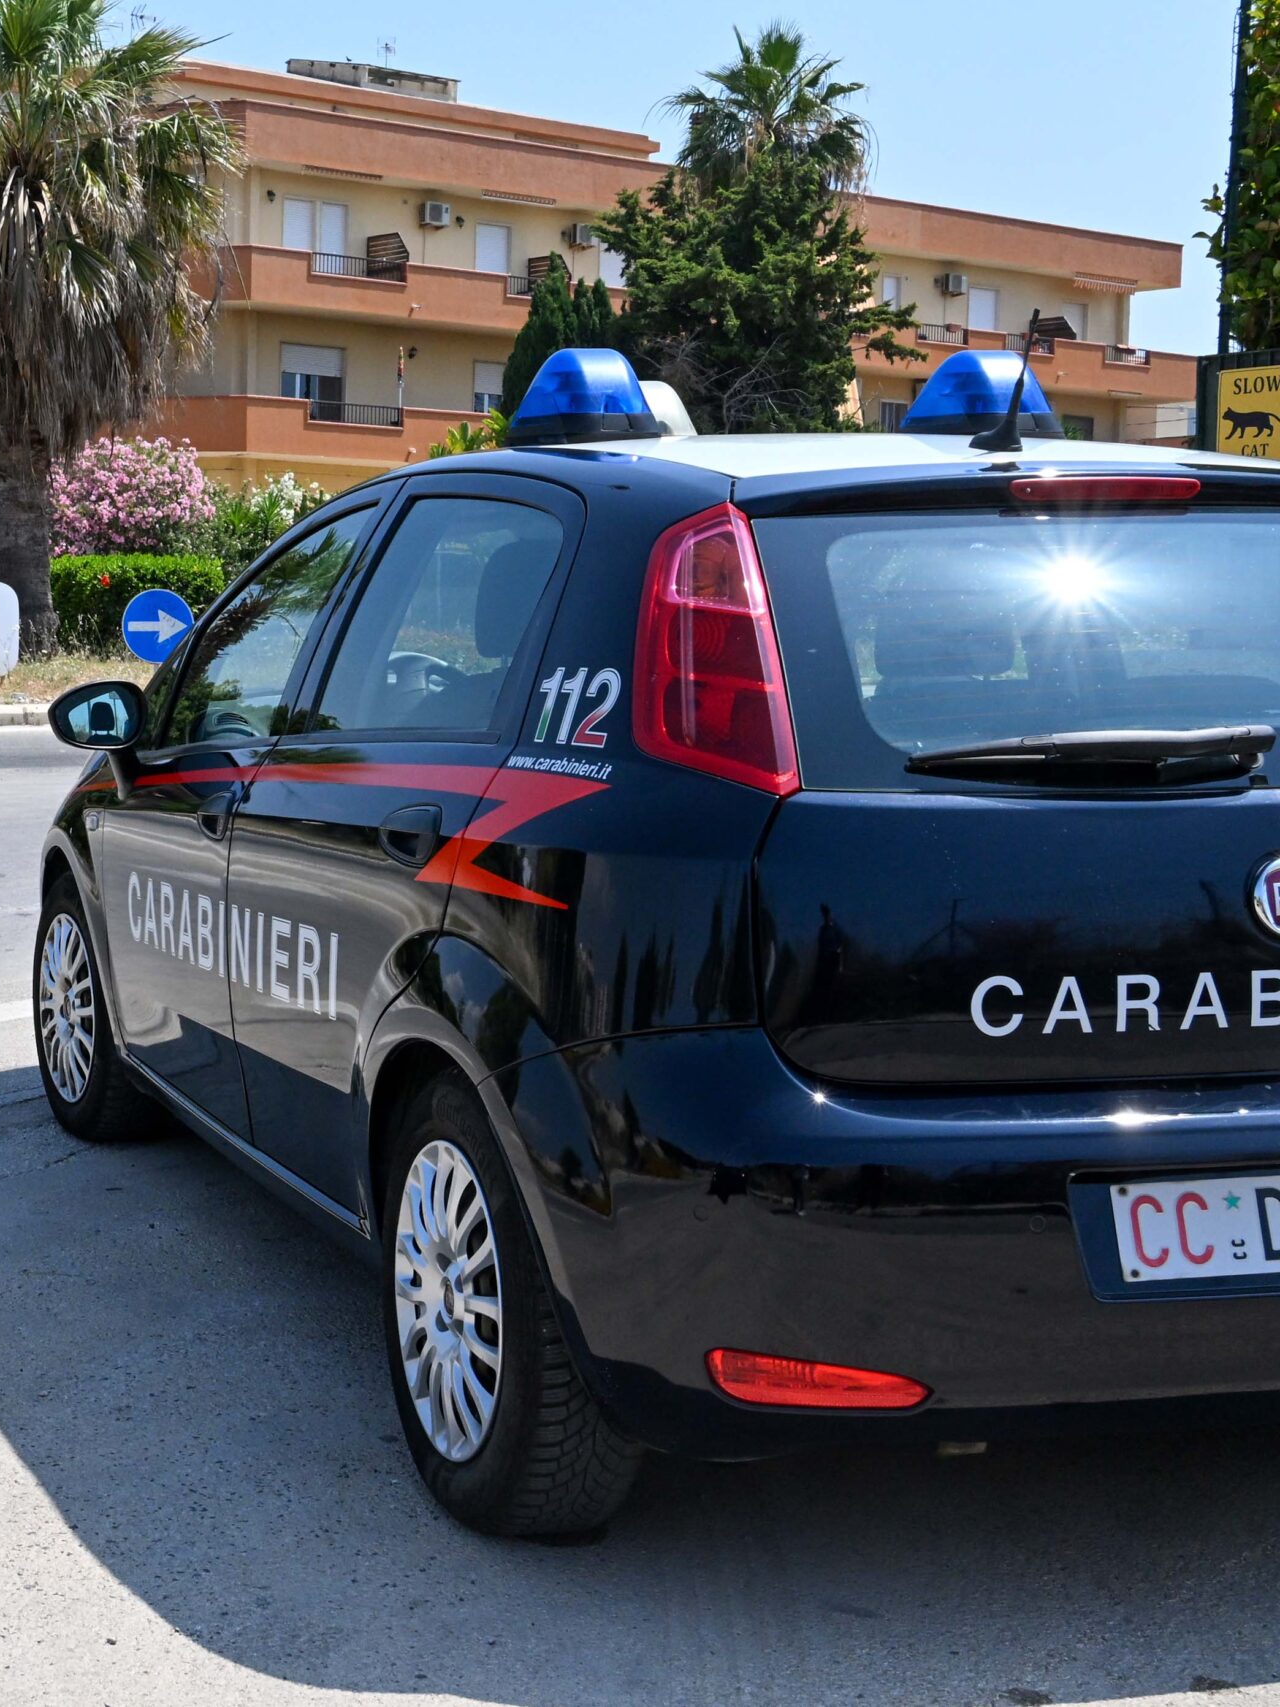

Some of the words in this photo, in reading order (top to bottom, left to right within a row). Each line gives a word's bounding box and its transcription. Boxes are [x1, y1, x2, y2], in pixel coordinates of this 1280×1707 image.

[1233, 375, 1280, 395] SLOW
[1241, 443, 1269, 457] CAT
[534, 666, 622, 748] 112
[507, 754, 613, 780] www.carabinieri.it
[128, 871, 339, 1021] CARABINIERI
[1130, 1191, 1215, 1269] CC
